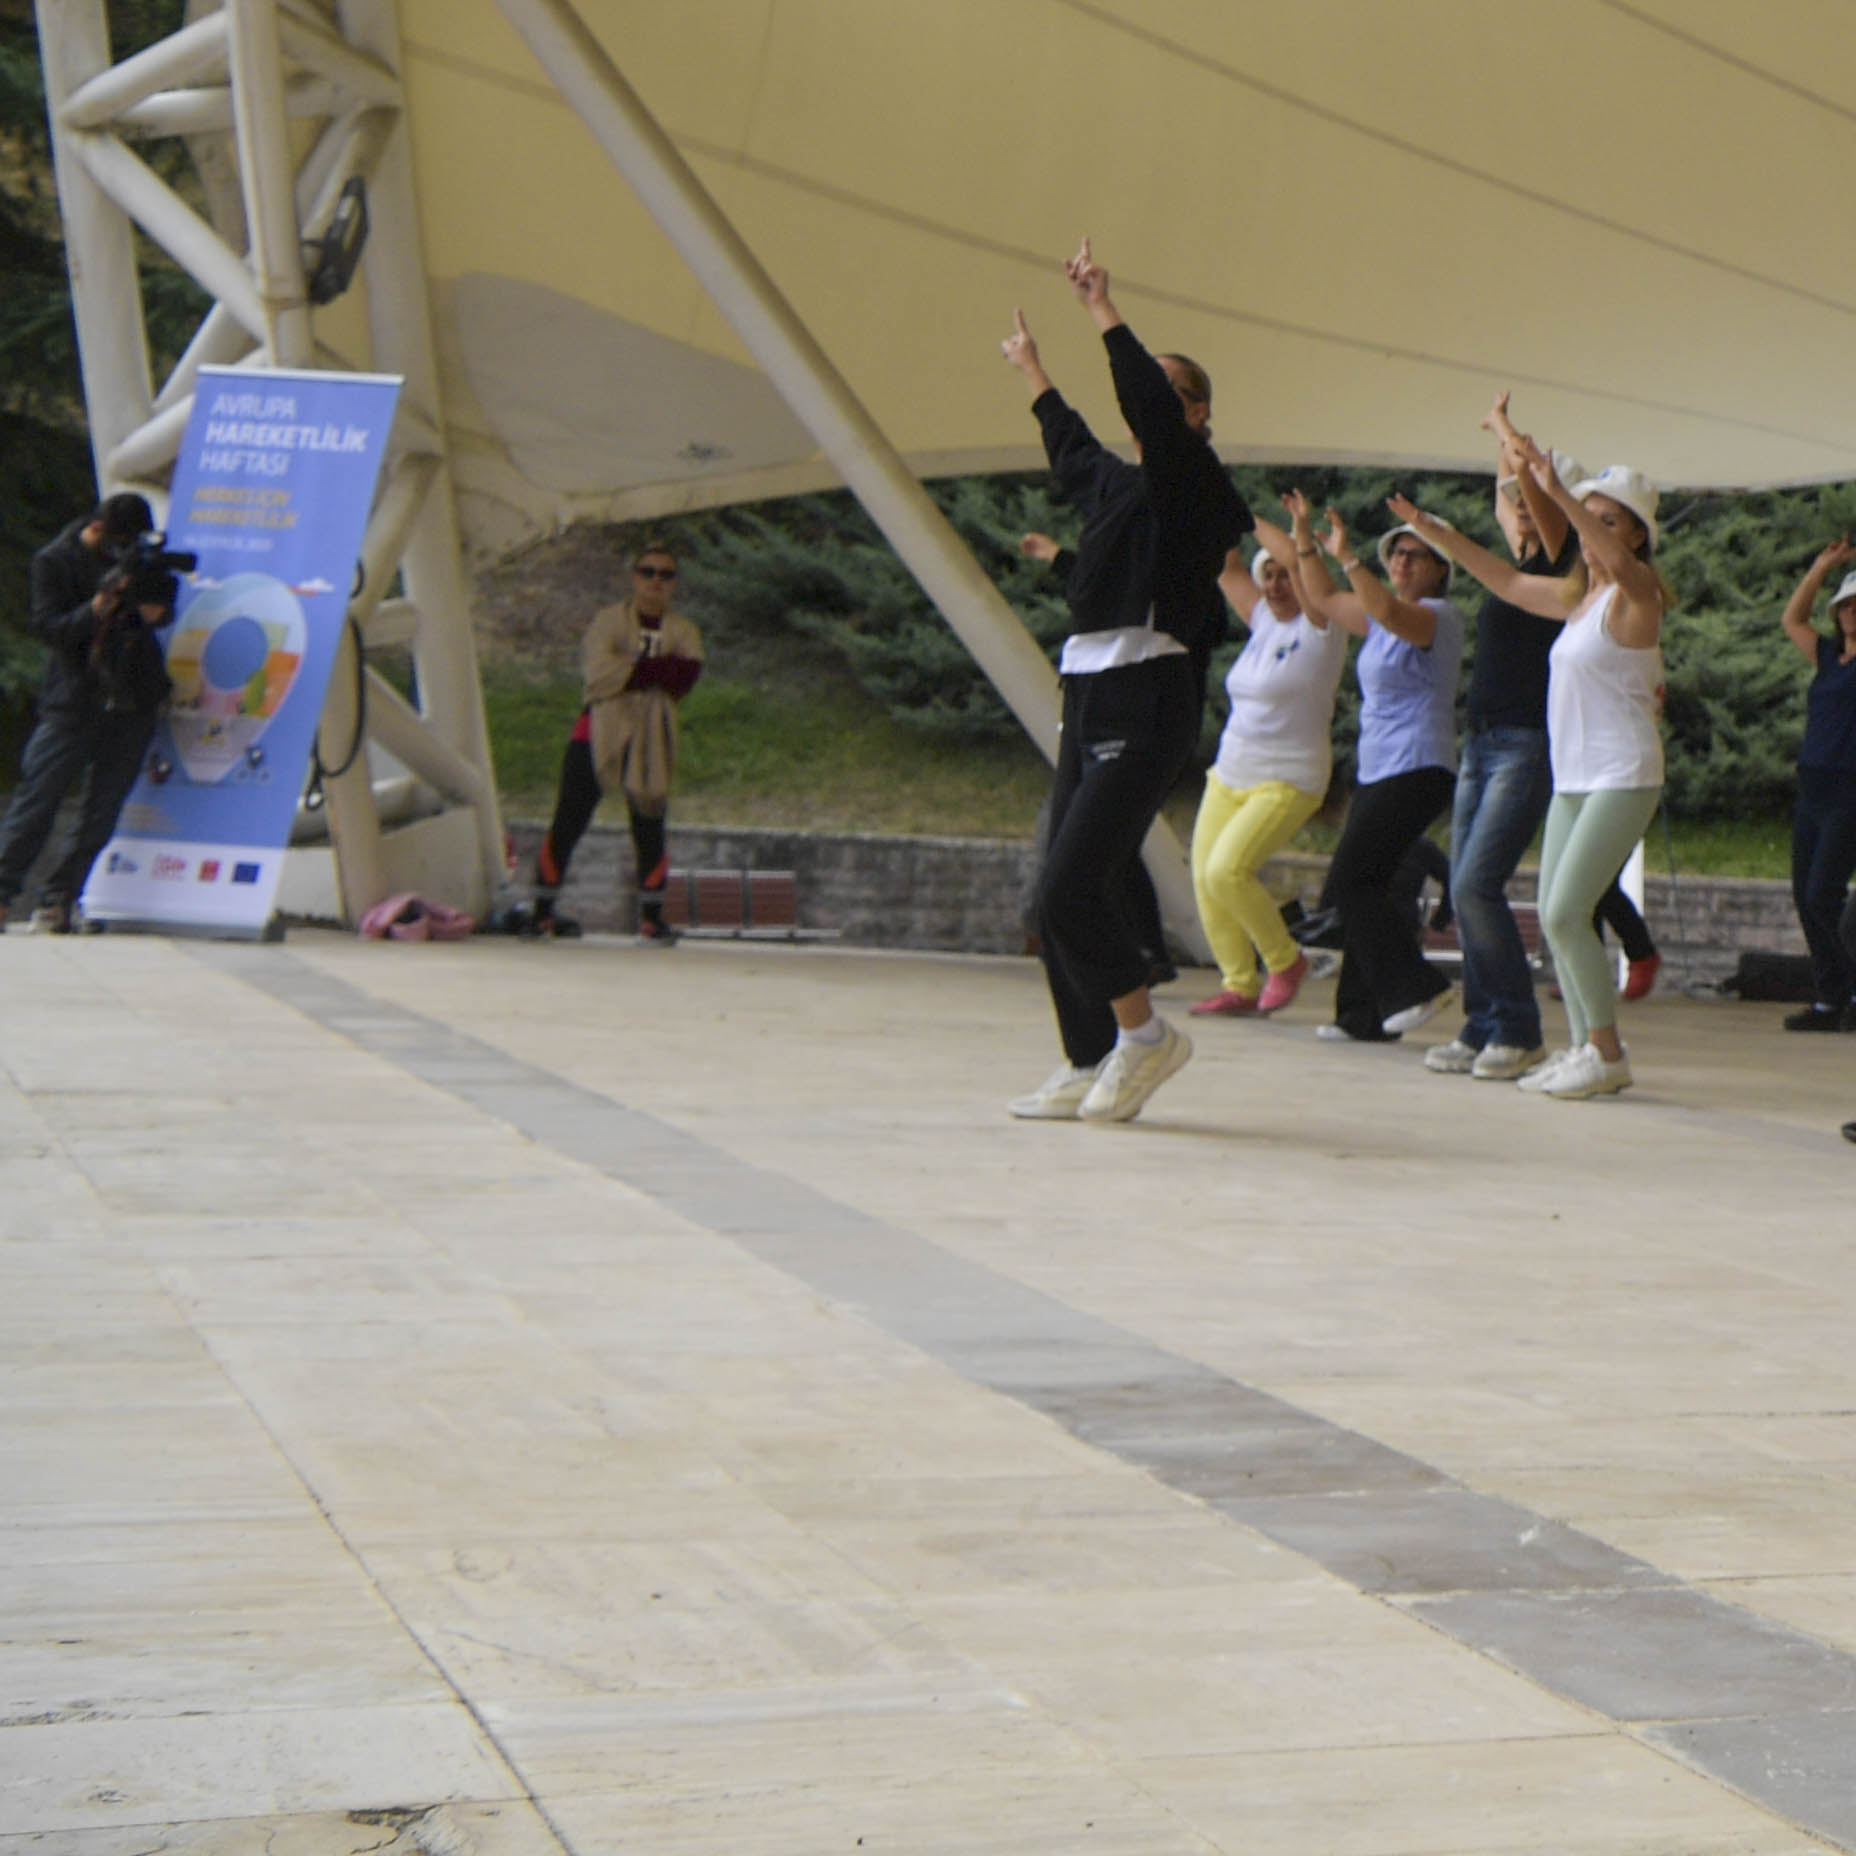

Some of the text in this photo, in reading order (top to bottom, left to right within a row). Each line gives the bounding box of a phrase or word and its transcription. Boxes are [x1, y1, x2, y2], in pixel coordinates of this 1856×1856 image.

[211, 394, 297, 419] AVRUPA
[205, 420, 369, 452] HAREKETLİLİK
[199, 450, 290, 475] HAFTASI
